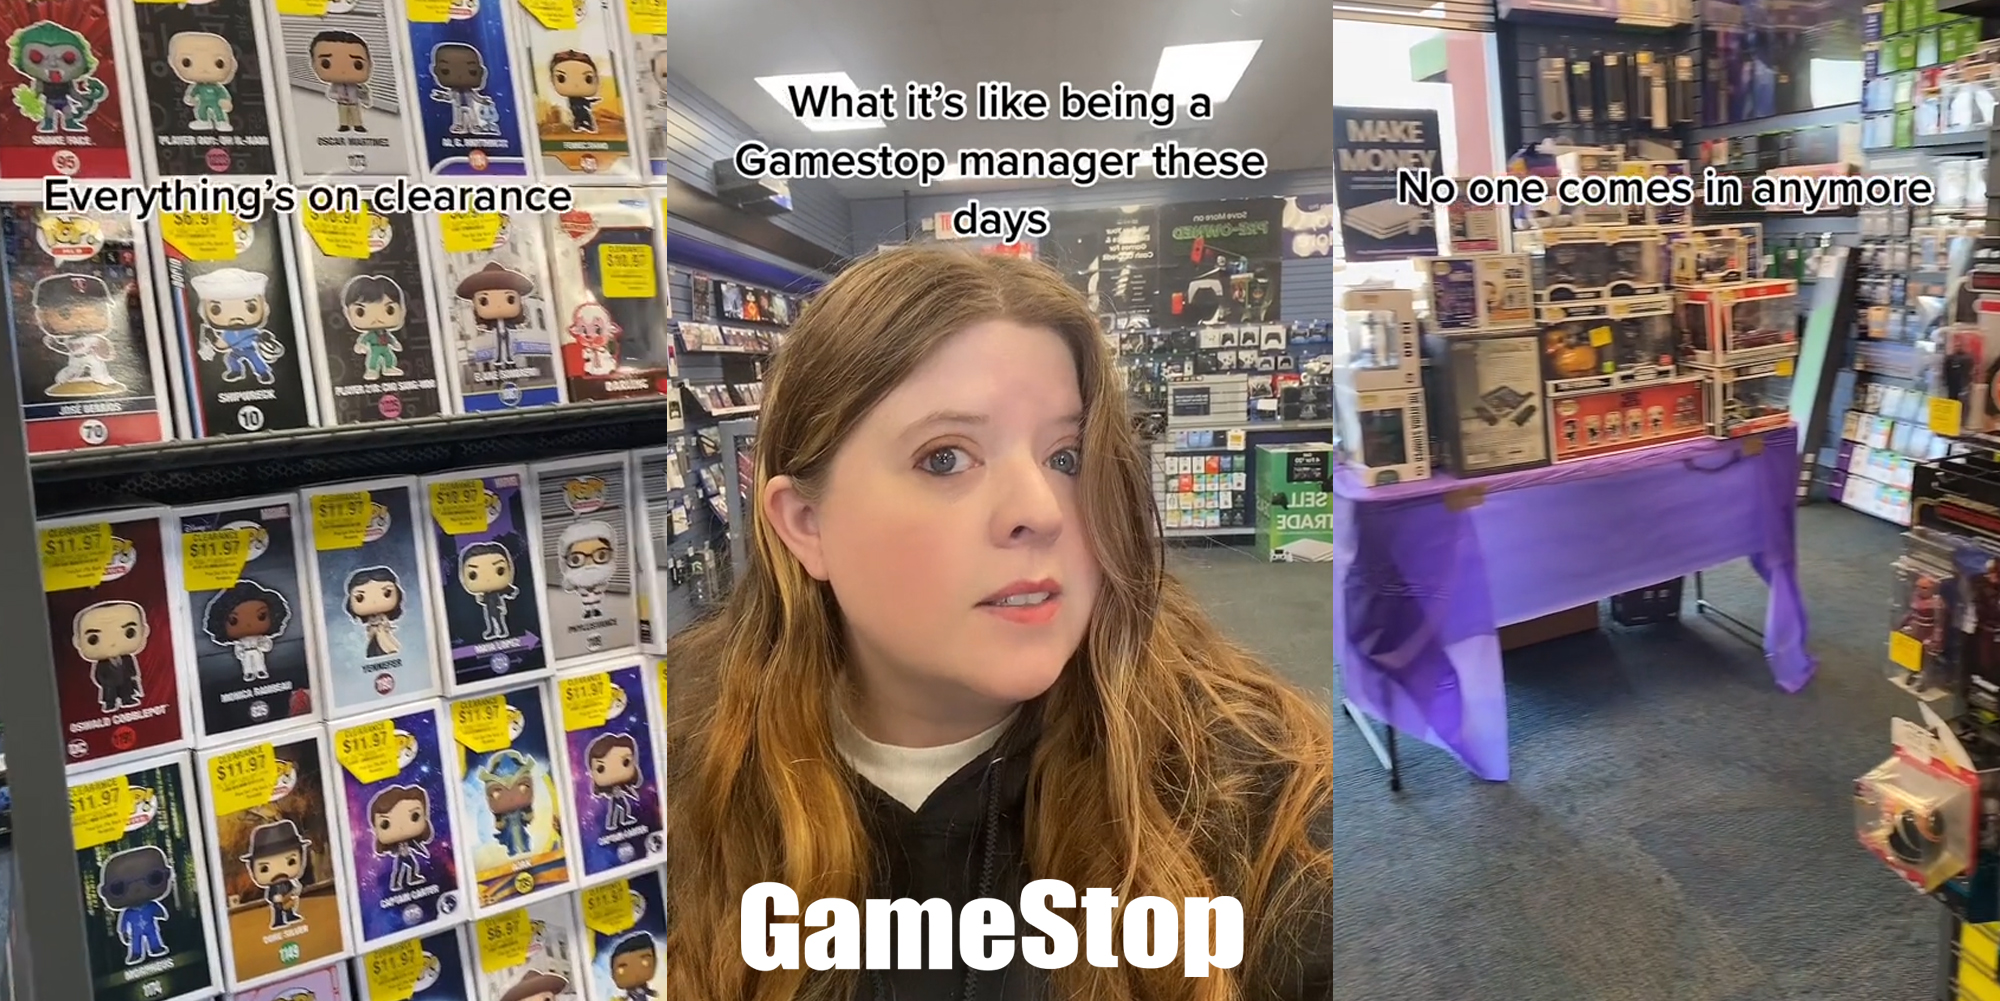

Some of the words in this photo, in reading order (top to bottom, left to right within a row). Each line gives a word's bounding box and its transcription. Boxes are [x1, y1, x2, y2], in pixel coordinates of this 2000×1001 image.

[1346, 119, 1425, 142] MAKE
[56, 155, 77, 169] 95
[1338, 148, 1437, 172] MONEY
[217, 389, 277, 404] SHIPWRECK
[240, 410, 260, 426] 10
[84, 424, 103, 439] 70
[48, 522, 101, 538] CLEARANCE
[193, 531, 239, 543] CLEARANCE
[45, 533, 102, 556] $11.97
[190, 539, 240, 558] $11.97
[566, 681, 604, 701] $11.97
[459, 704, 500, 723] $11.97
[343, 731, 387, 753] $11.97
[218, 744, 263, 764] CLEARANCE
[216, 754, 265, 781] $11.97
